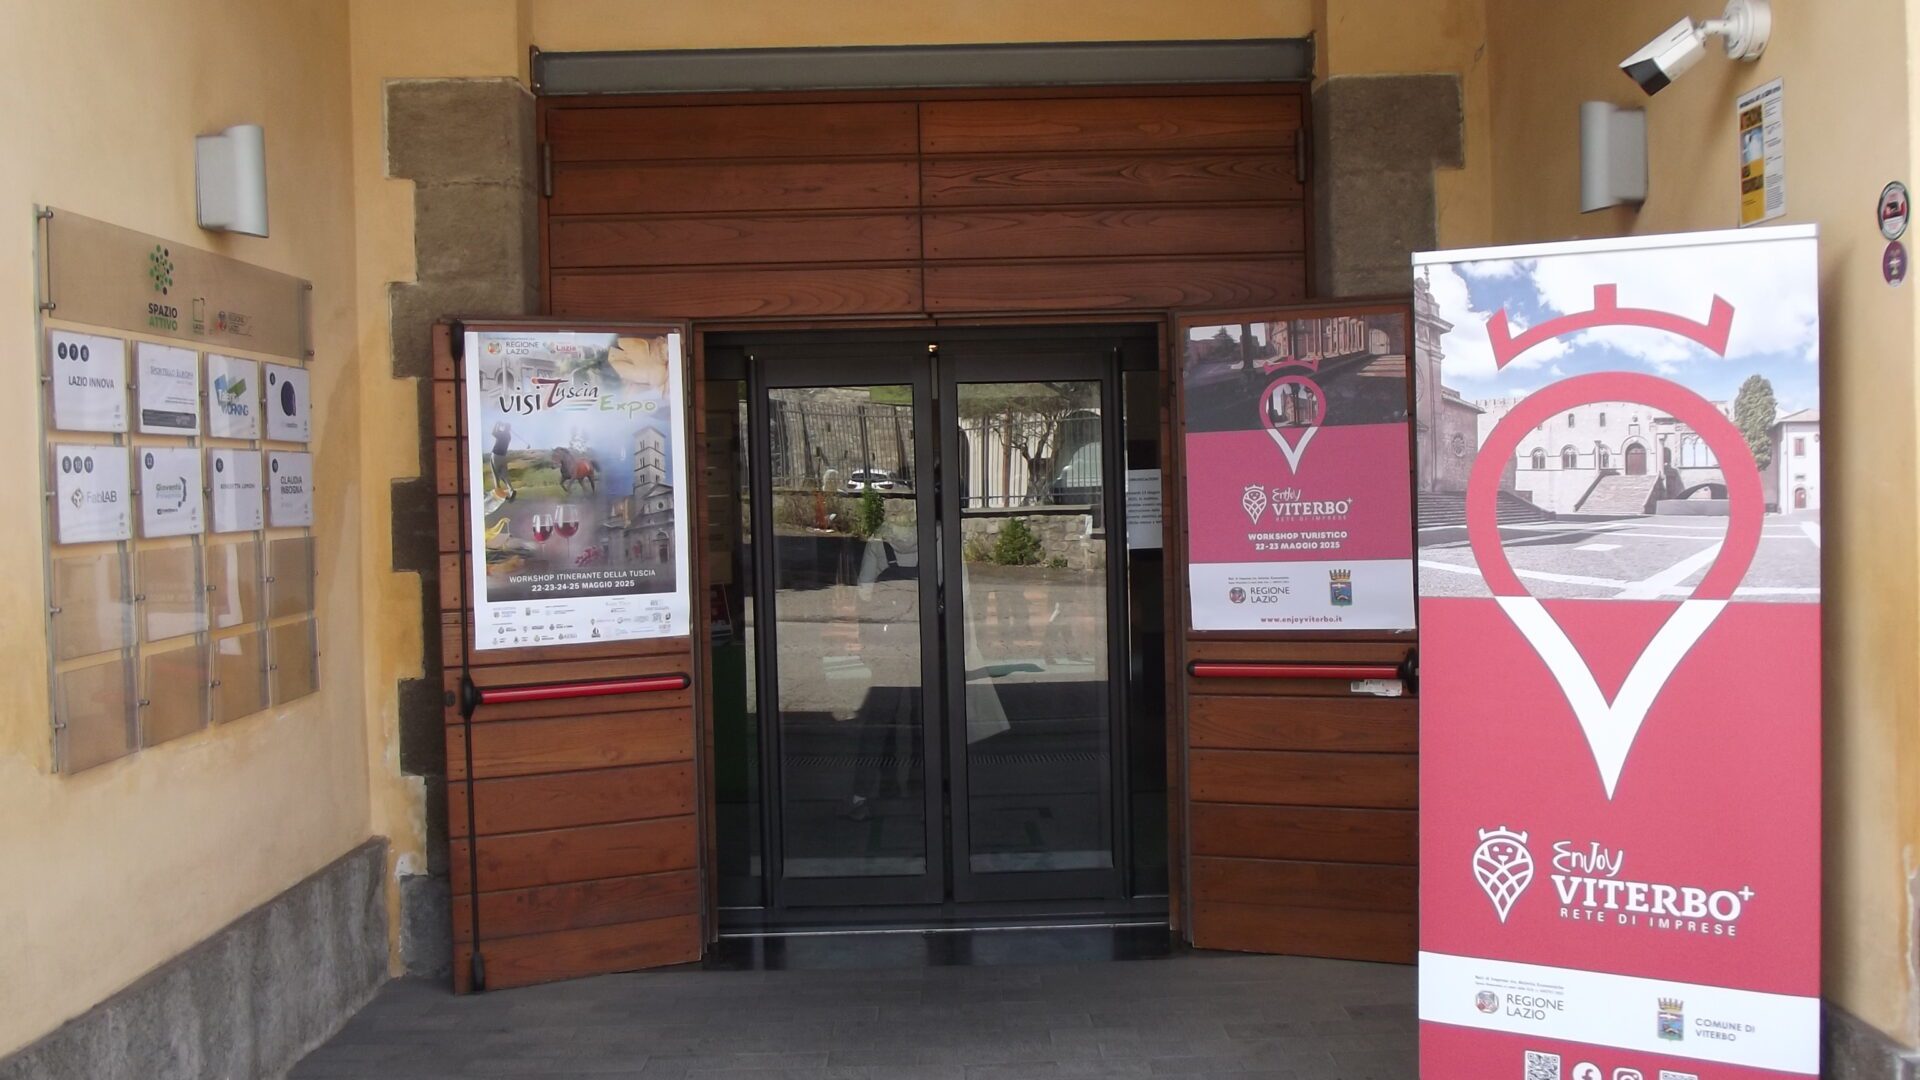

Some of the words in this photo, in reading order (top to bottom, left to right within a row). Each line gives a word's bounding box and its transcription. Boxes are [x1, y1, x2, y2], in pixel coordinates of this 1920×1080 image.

[148, 302, 178, 319] SPAZIO
[149, 316, 178, 332] ATTIVO
[505, 341, 540, 349] REGIONE
[68, 375, 88, 388] LAZIO
[89, 377, 115, 390] INNOVA
[599, 394, 657, 420] Expo
[280, 475, 303, 485] CLAUDIA
[86, 490, 118, 504] FabLAB
[1248, 532, 1299, 541] WORKSHOP
[1300, 530, 1348, 540] TURISTICO
[1255, 542, 1279, 551] 22-23
[1280, 541, 1318, 550] MAGGIO
[1319, 541, 1341, 549] 2025
[509, 573, 555, 584] WORKSHOP
[556, 571, 601, 581] ITINERANTE
[603, 570, 628, 579] DELLA
[629, 569, 656, 578] TUSCIA
[531, 582, 580, 592] 22-23-24-25
[581, 580, 613, 590] MAGGIO
[614, 579, 635, 588] 2025
[1250, 586, 1290, 595] REGIONE
[1250, 595, 1278, 604] LAZIO
[1260, 615, 1343, 625] www.enjoyviterbo.it
[1559, 907, 1605, 923] RETE
[1618, 913, 1637, 925] DI
[1648, 916, 1737, 937] IMPRESE
[1506, 993, 1565, 1012] REGIONE
[1506, 1005, 1546, 1021] LAZIO
[1695, 1017, 1743, 1032] COMUNE
[1744, 1024, 1756, 1033] DI
[1695, 1028, 1737, 1042] VITERBO
